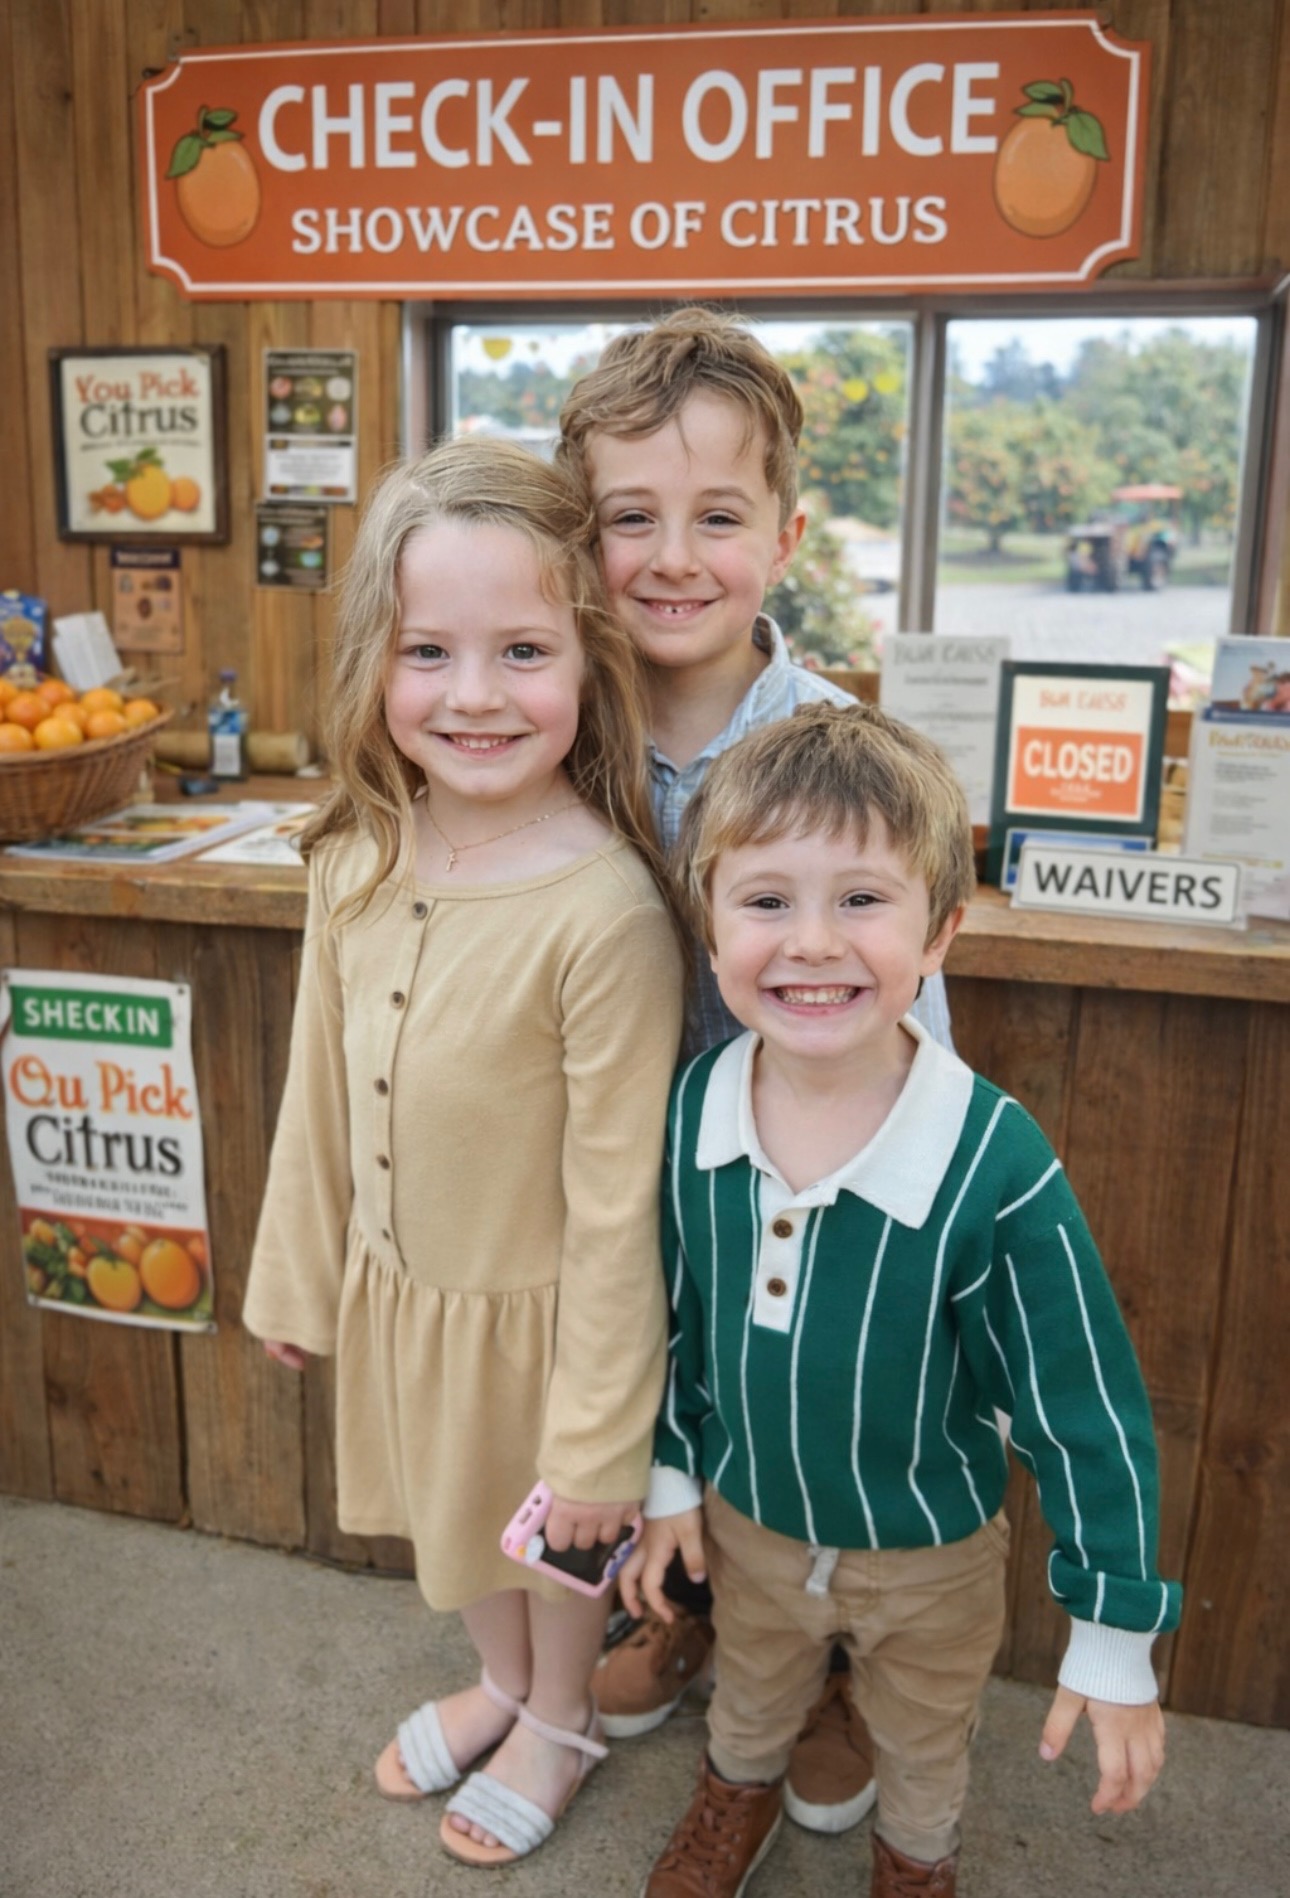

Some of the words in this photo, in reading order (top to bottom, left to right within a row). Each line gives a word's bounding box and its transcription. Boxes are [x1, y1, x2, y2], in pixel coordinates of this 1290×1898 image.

[258, 74, 654, 172] CHECK-IN
[682, 62, 1000, 162] OFFICE
[291, 204, 615, 254] SHOWCASE
[630, 201, 706, 250] OF
[720, 196, 948, 247] CITRUS
[75, 373, 132, 404] You
[138, 367, 200, 400] Pick
[80, 401, 198, 438] Citrus
[1023, 739, 1133, 784] CLOSED
[1034, 861, 1222, 909] WAIVERS
[95, 1060, 193, 1121] Pick
[26, 1113, 183, 1177] Citrus
